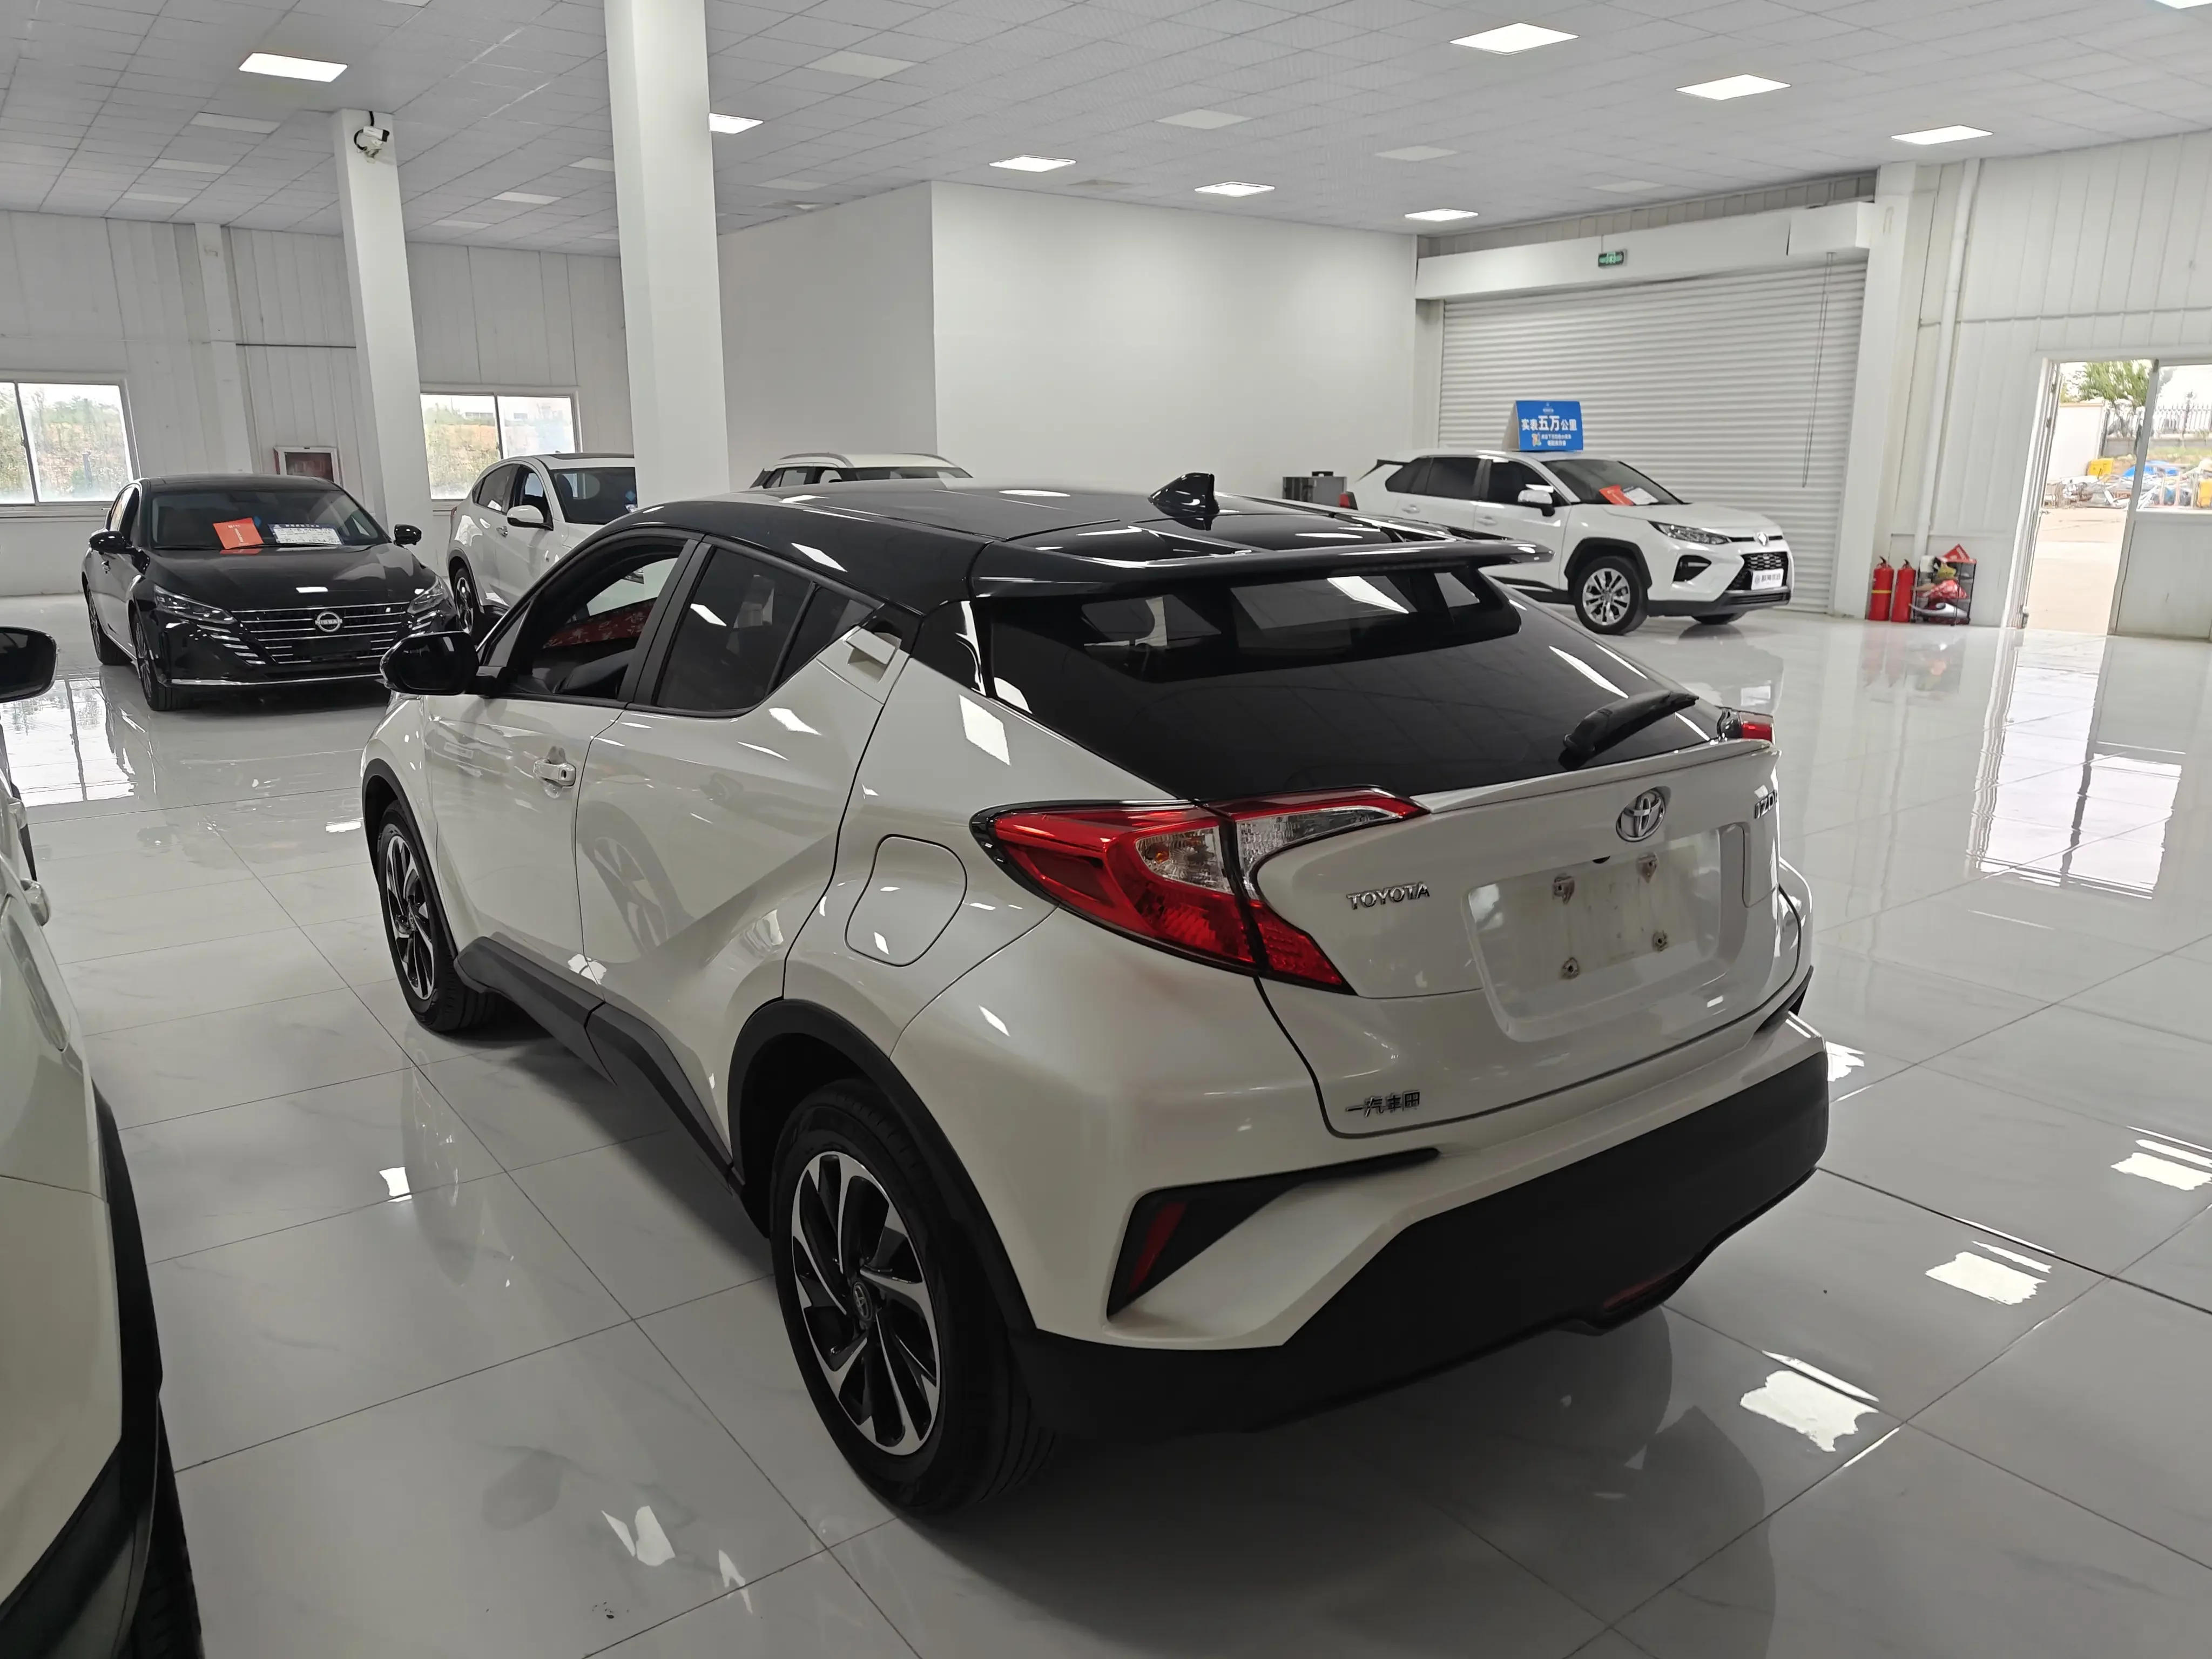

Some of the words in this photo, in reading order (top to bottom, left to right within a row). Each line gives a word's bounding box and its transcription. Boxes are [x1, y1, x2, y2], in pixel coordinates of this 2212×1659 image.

[1754, 790, 1778, 819] IZO
[1346, 882, 1430, 910] TOYOTA
[1346, 1090, 1420, 1117] 一汽丰田
